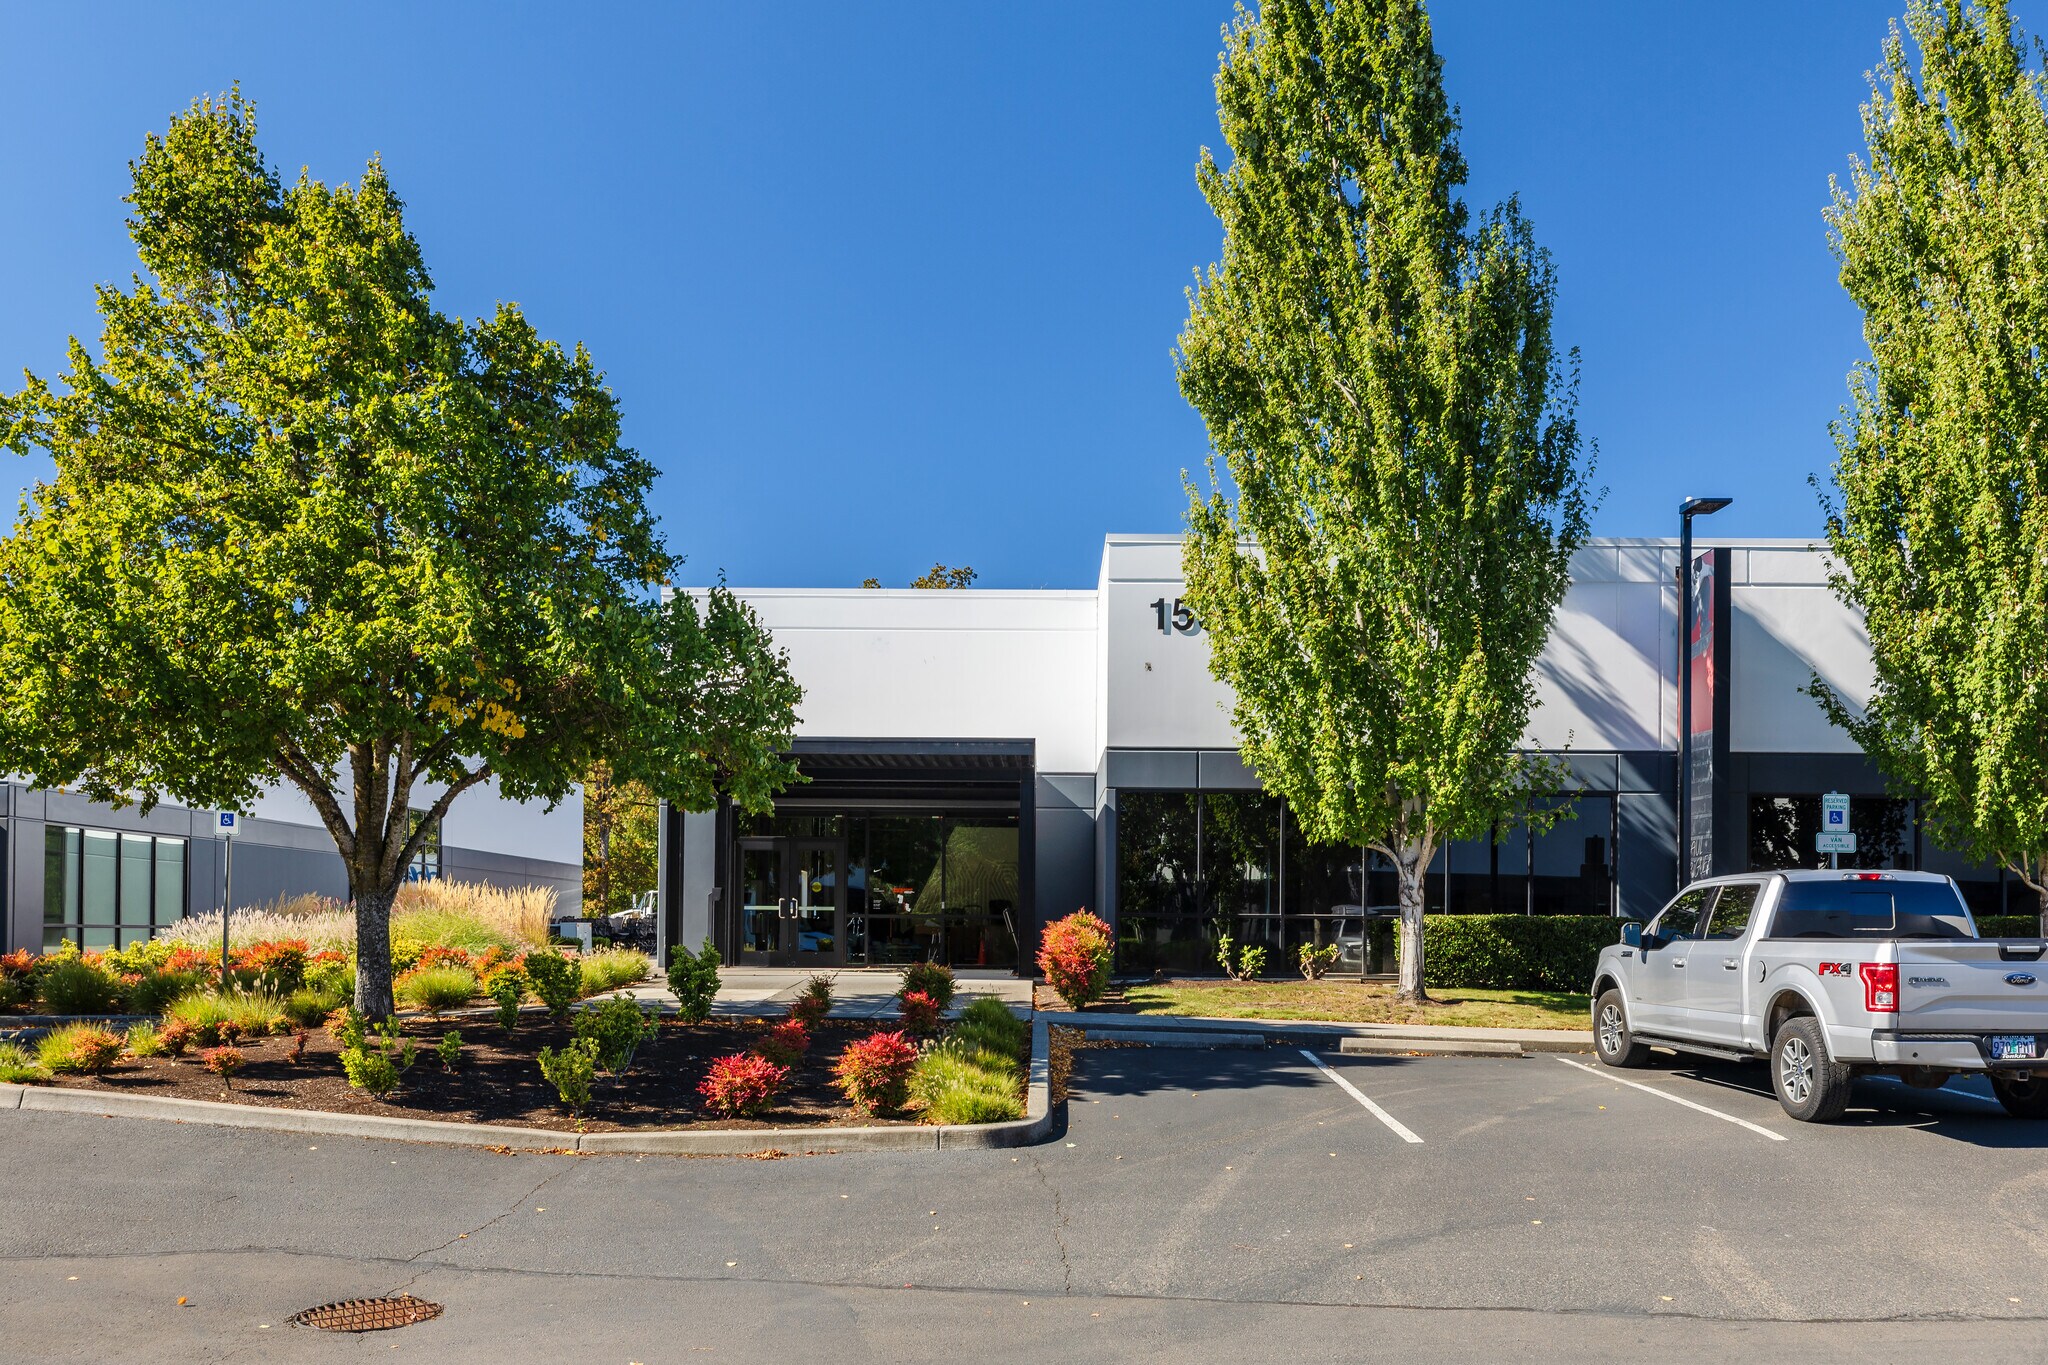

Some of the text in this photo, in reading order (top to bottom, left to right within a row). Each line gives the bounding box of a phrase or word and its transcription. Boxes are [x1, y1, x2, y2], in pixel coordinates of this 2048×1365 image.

[1150, 598, 1209, 631] 15
[1818, 962, 1852, 975] FX4
[2011, 975, 2033, 983] Ford
